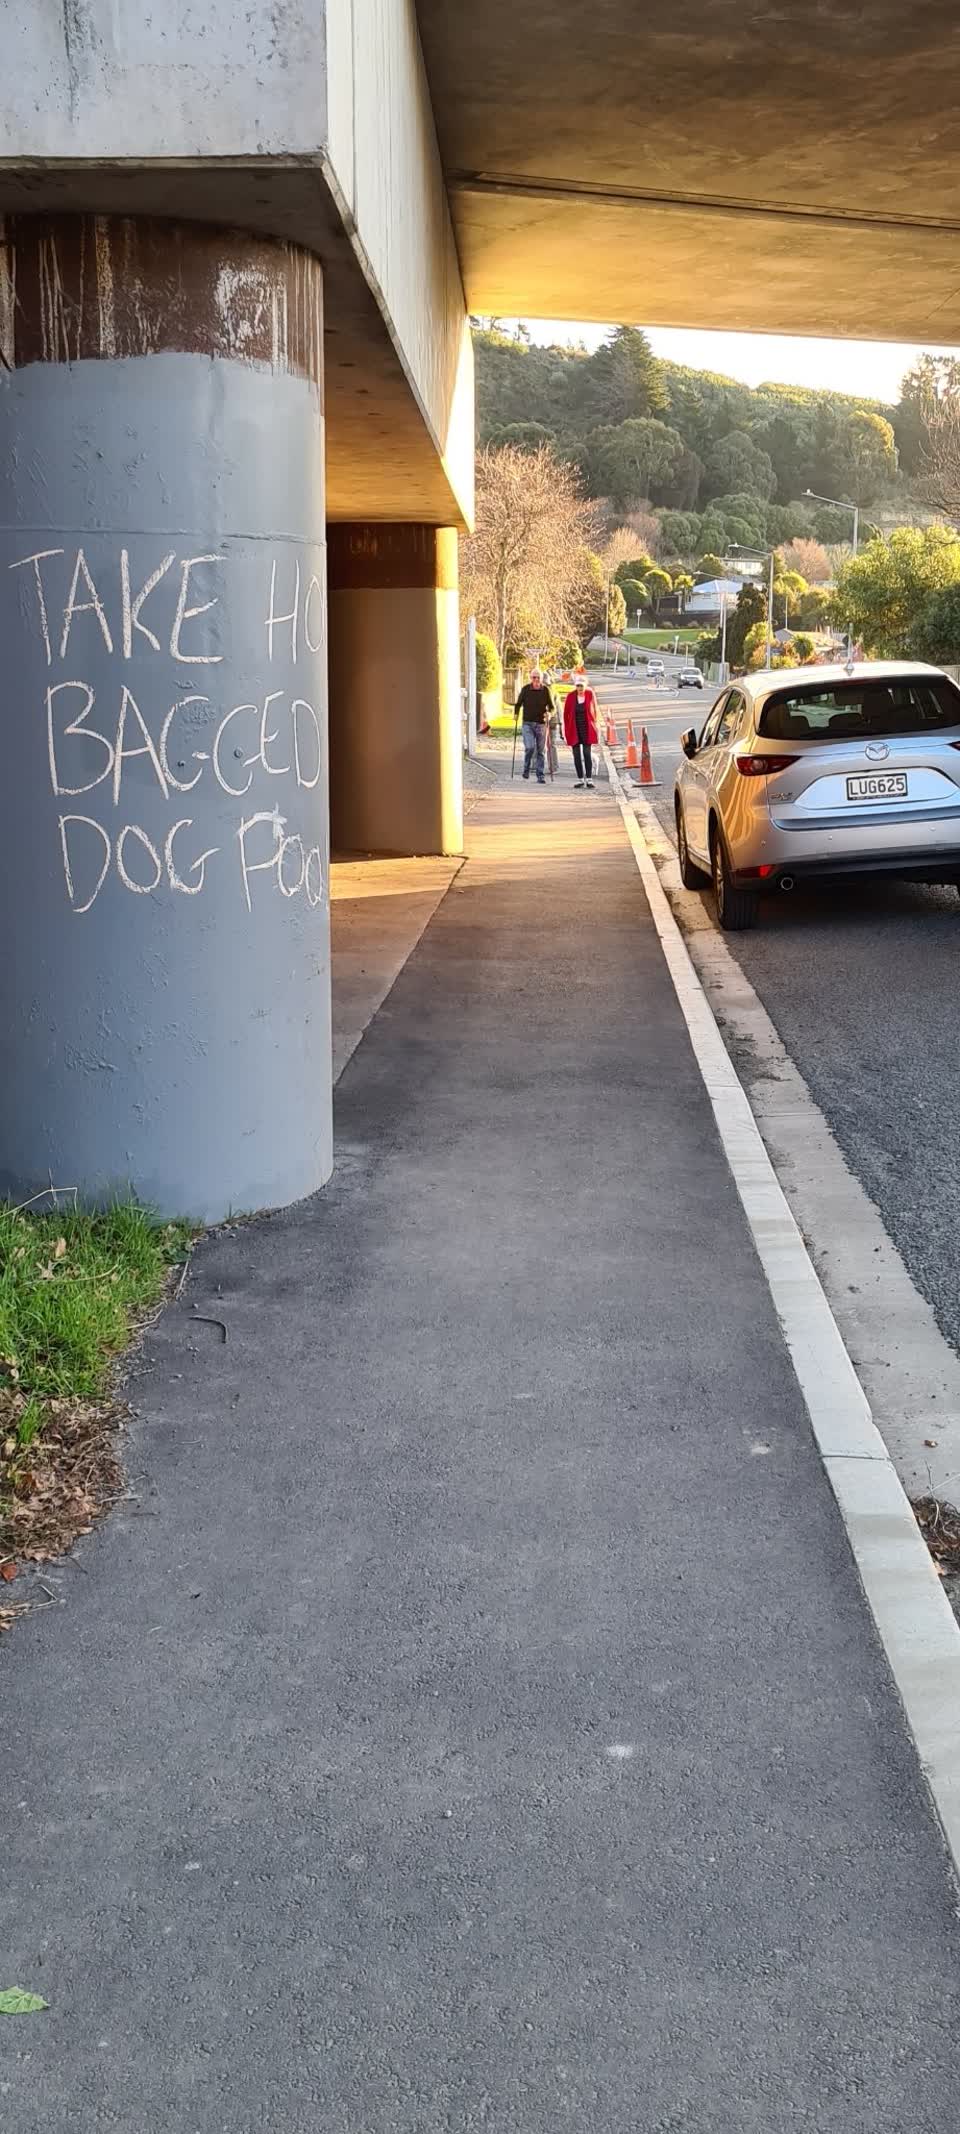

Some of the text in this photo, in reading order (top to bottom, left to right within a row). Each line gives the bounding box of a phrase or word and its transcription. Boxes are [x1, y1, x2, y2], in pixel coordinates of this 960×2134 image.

[8, 548, 229, 666] TAKE
[44, 680, 321, 806] BAGGED
[849, 777, 905, 796] LUG625
[58, 814, 222, 913] DOG
